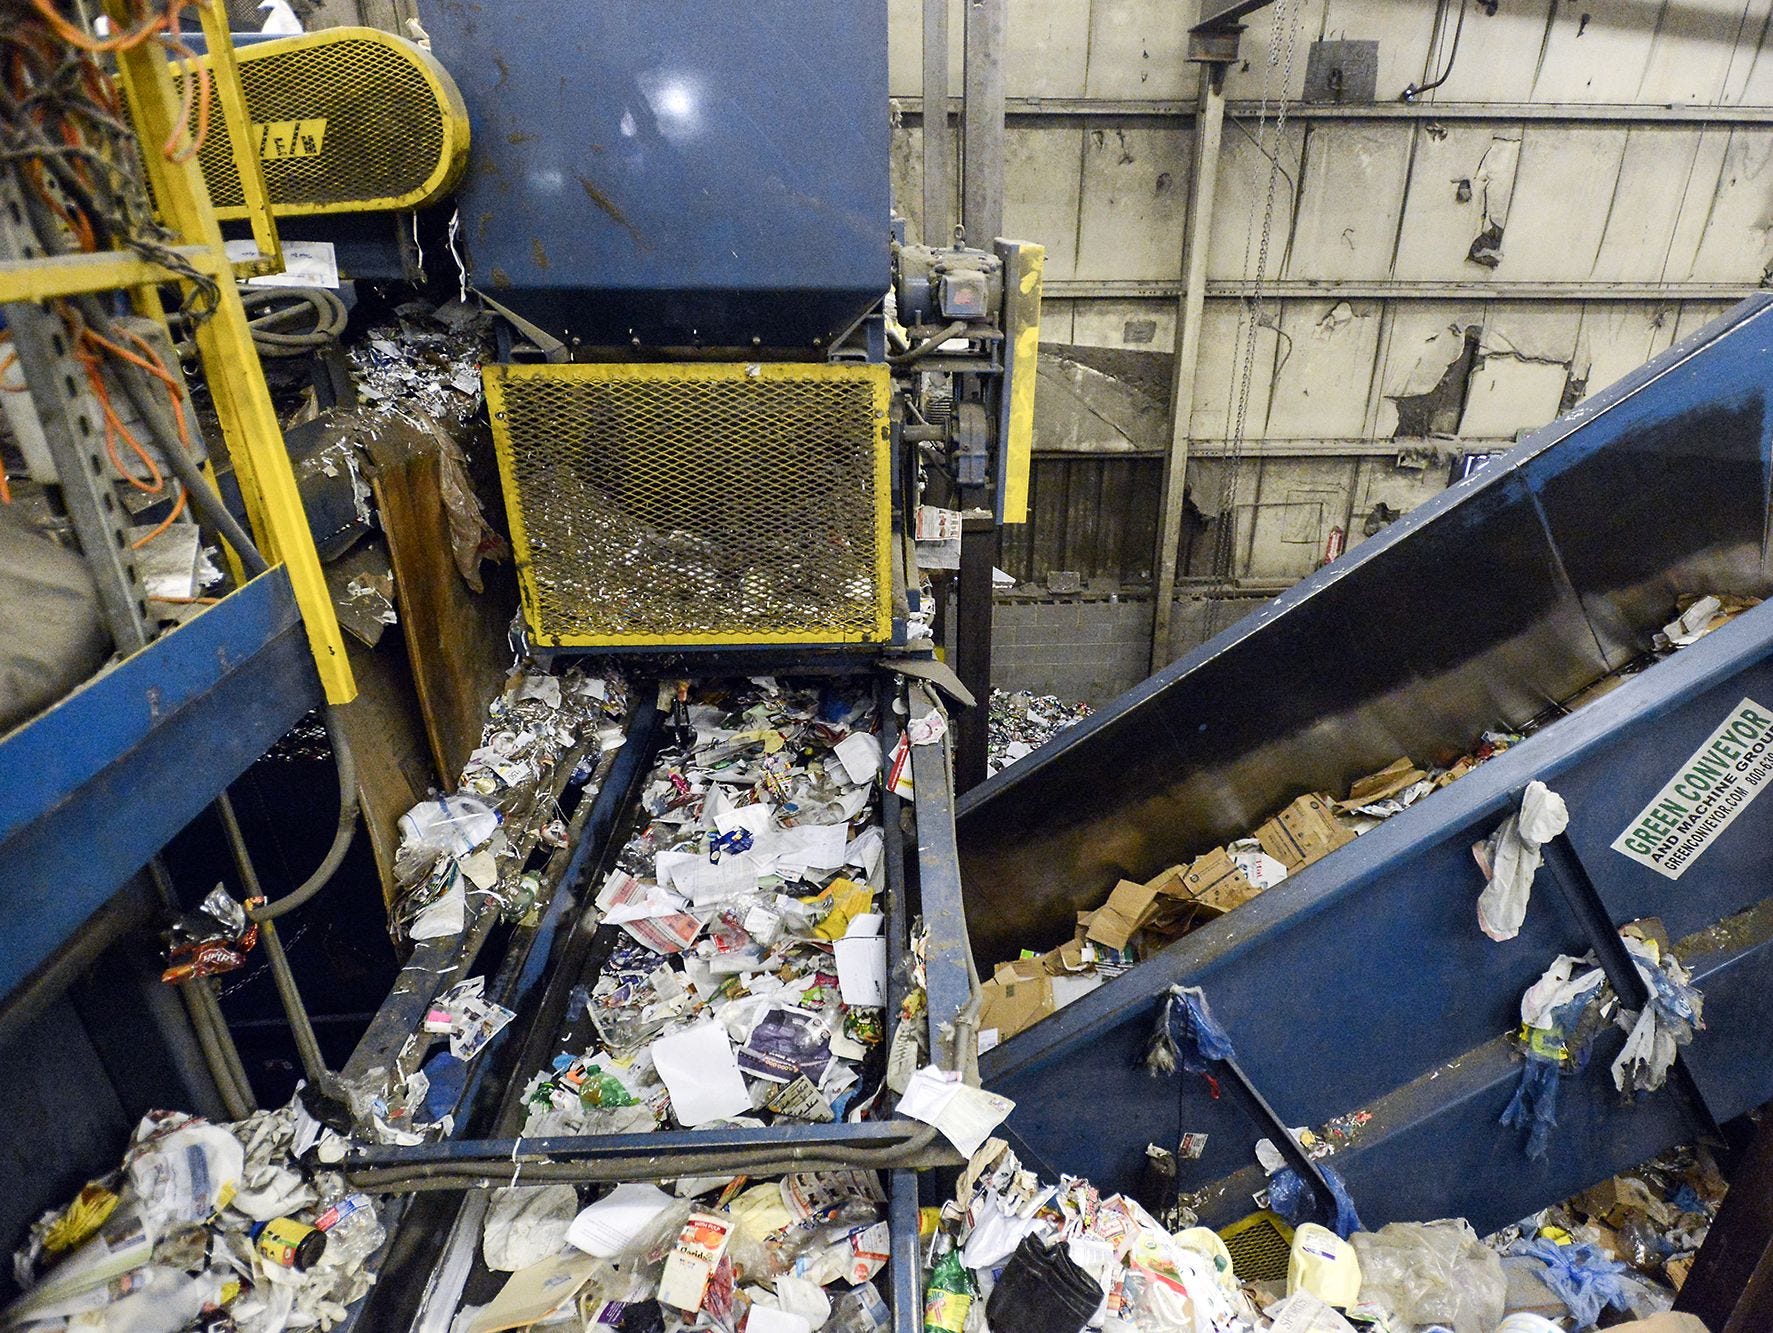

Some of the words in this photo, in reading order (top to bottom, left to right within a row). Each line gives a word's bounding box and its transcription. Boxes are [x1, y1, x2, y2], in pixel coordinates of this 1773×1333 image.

[1624, 797, 1689, 855] GREEN
[1674, 708, 1772, 801] CONVEYOR
[1651, 834, 1680, 863] AND
[1677, 773, 1738, 834] MACHINE
[1664, 786, 1749, 871] GREENCONVEYOR.COM
[1279, 1295, 1308, 1330] SPORTS
